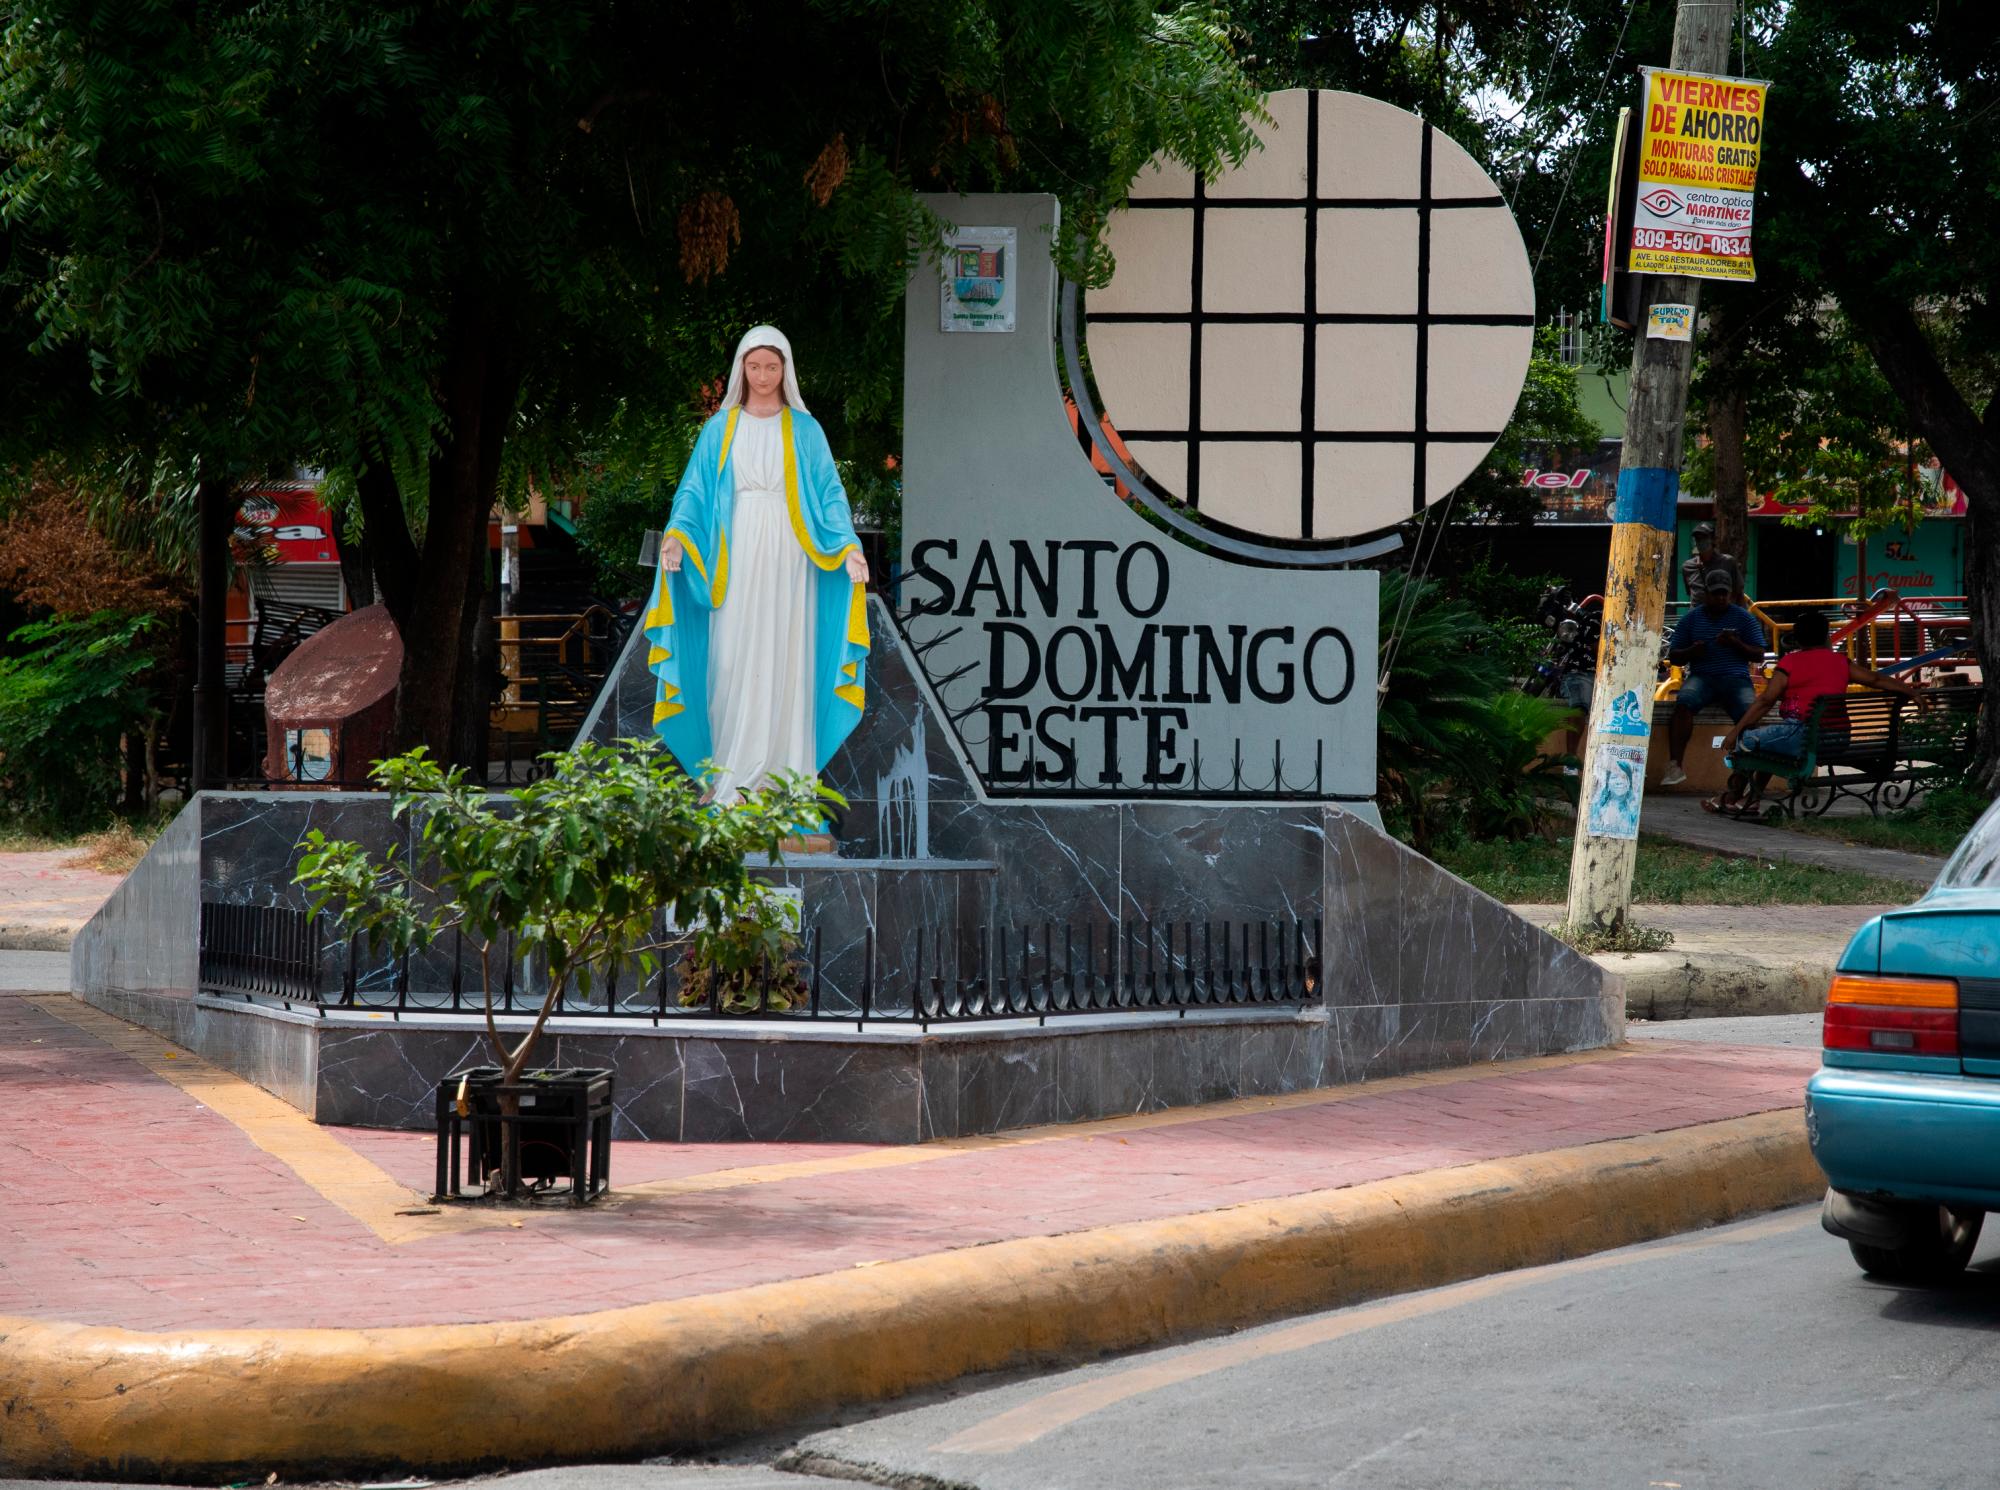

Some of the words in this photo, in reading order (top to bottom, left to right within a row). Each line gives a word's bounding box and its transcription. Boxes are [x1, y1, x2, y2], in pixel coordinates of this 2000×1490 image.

[1660, 77, 1760, 113] VIERNES
[1650, 104, 1677, 135] DE
[1680, 108, 1760, 145] AHORRO
[1651, 139, 1714, 163] MONTURAS
[1717, 150, 1757, 168] GRATIS
[1643, 158, 1668, 177] SOLO
[1669, 161, 1697, 180] PAGAS
[1698, 165, 1715, 182] LOS
[1716, 166, 1757, 187] CRISTALES
[1686, 192, 1720, 204] centro
[1722, 196, 1753, 208] optico
[1686, 202, 1751, 221] MARTINEZ
[1635, 229, 1751, 255] 809-590-0834
[1636, 252, 1653, 261] AVE.
[1654, 253, 1669, 262] LOS
[1670, 255, 1737, 267] RESTAURADORES
[910, 538, 1170, 619] SANTO
[980, 621, 1356, 705] DOMINGO
[980, 703, 1189, 784] ESTE
